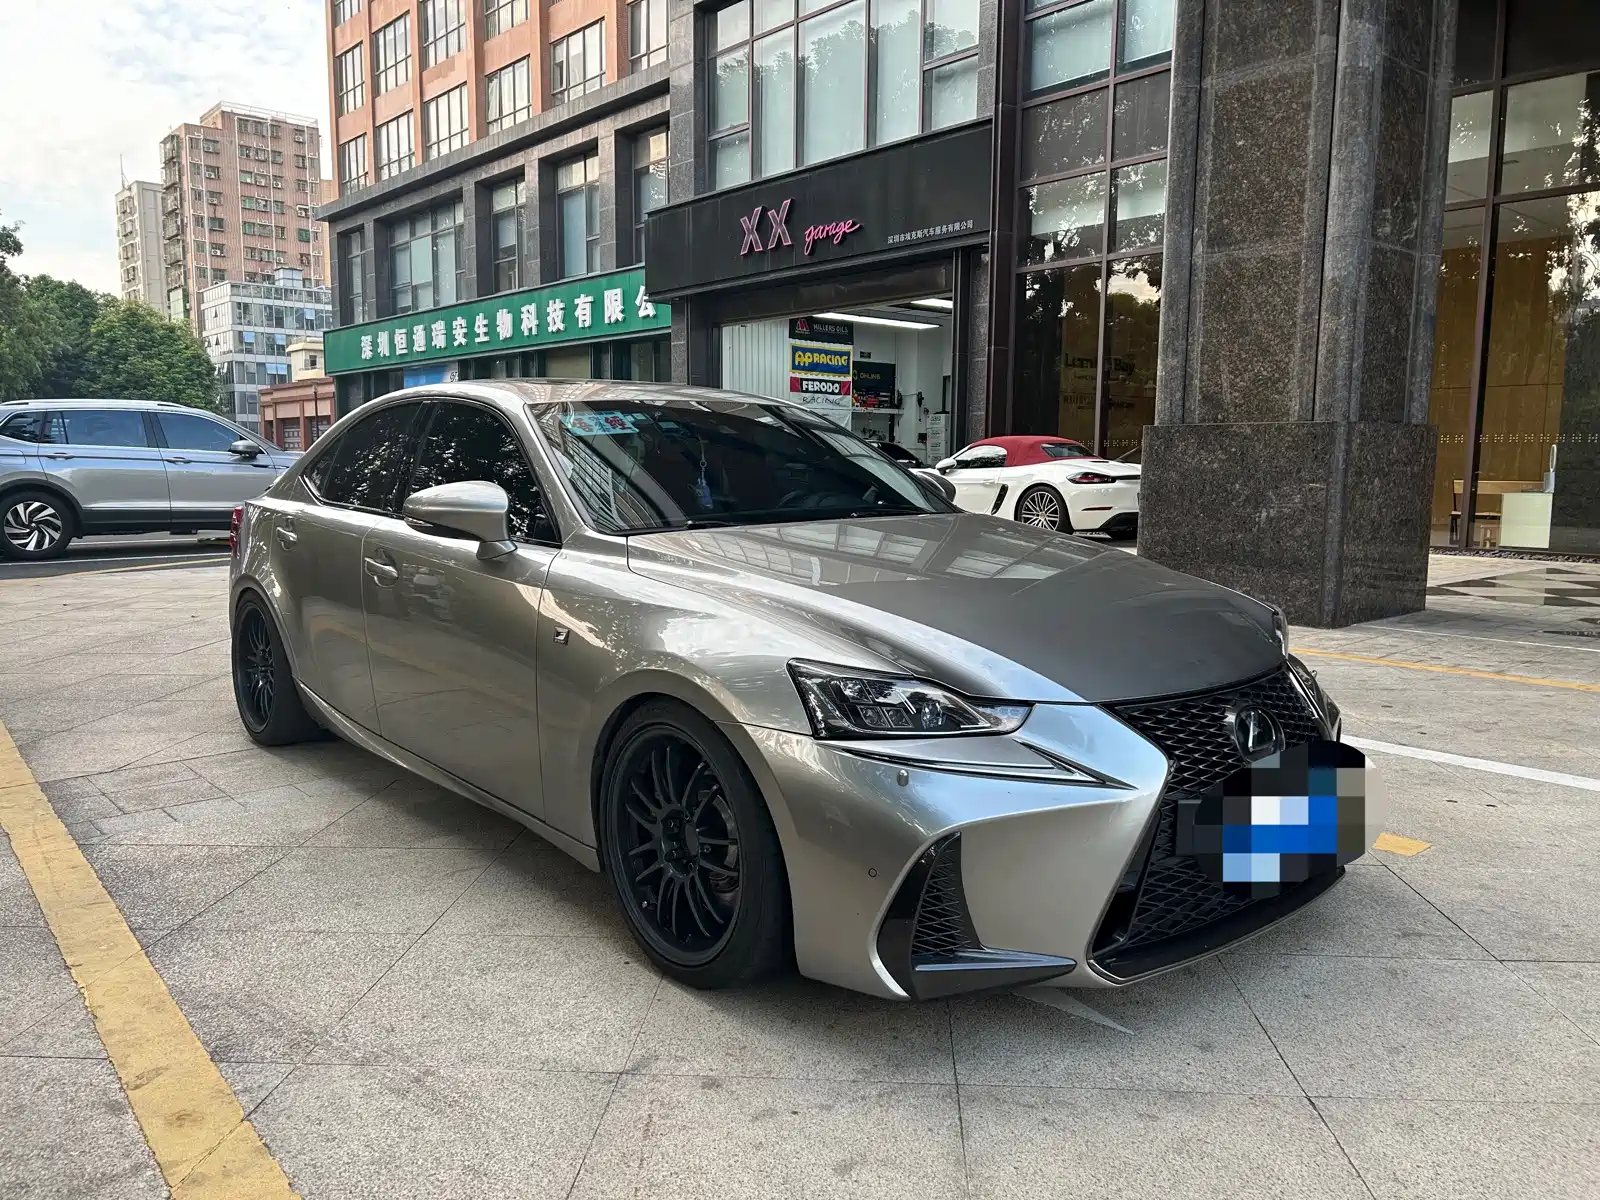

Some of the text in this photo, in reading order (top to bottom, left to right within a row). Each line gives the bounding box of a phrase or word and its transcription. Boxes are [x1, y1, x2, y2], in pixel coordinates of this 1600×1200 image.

[740, 199, 861, 255] XX garage
[813, 323, 836, 332] MILLERS
[802, 380, 840, 393] FERODO
[802, 396, 841, 405] RACING
